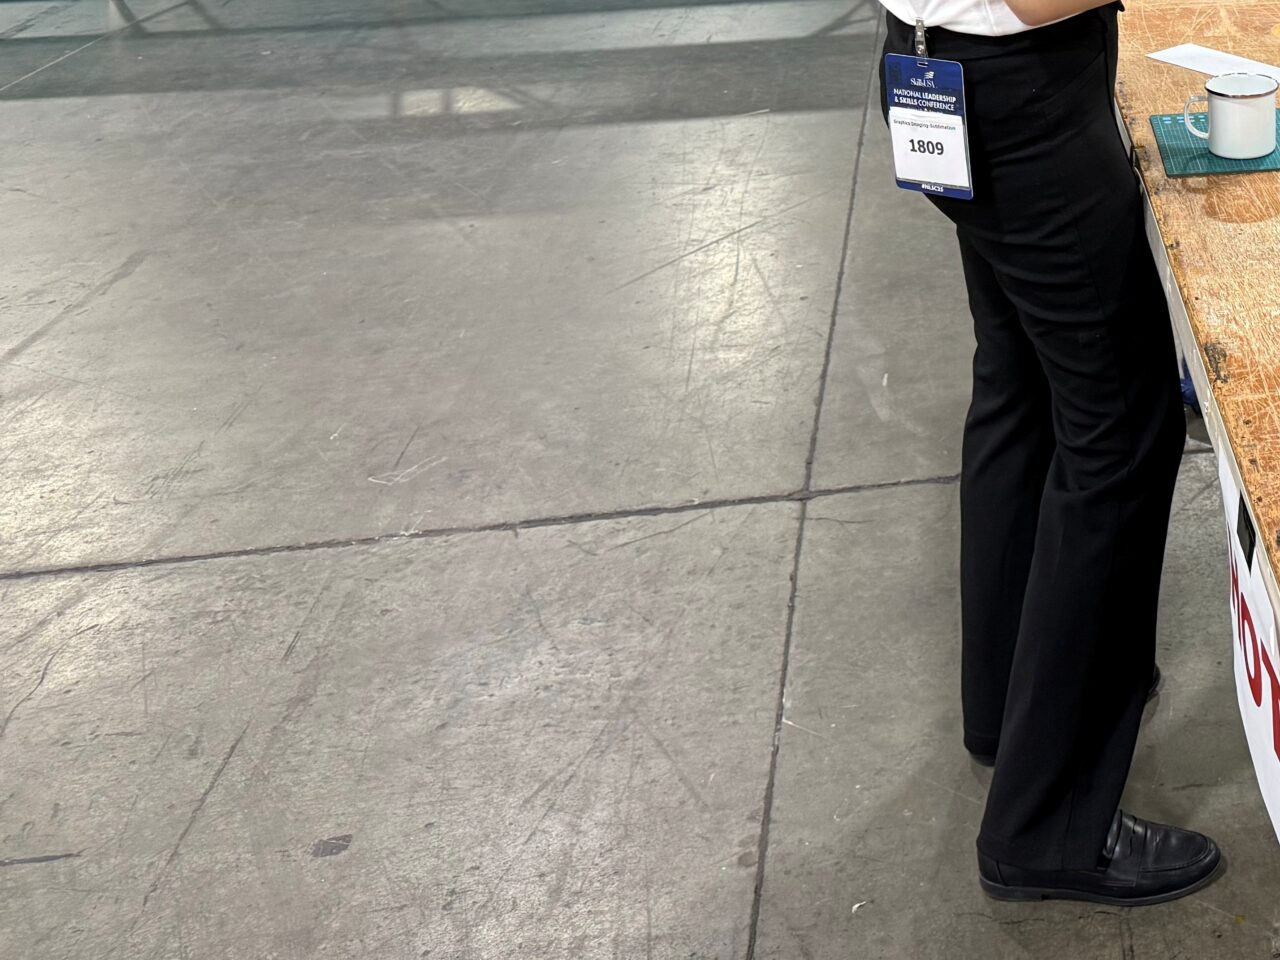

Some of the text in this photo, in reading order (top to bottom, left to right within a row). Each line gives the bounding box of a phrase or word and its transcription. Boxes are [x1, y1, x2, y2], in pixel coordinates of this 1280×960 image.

[910, 77, 935, 88] SkillsUSA
[893, 88, 957, 103] NATIONAL LEADERSHIP
[899, 97, 918, 106] SKILLS
[918, 99, 955, 111] CONFERENCE
[909, 139, 944, 156] 1809
